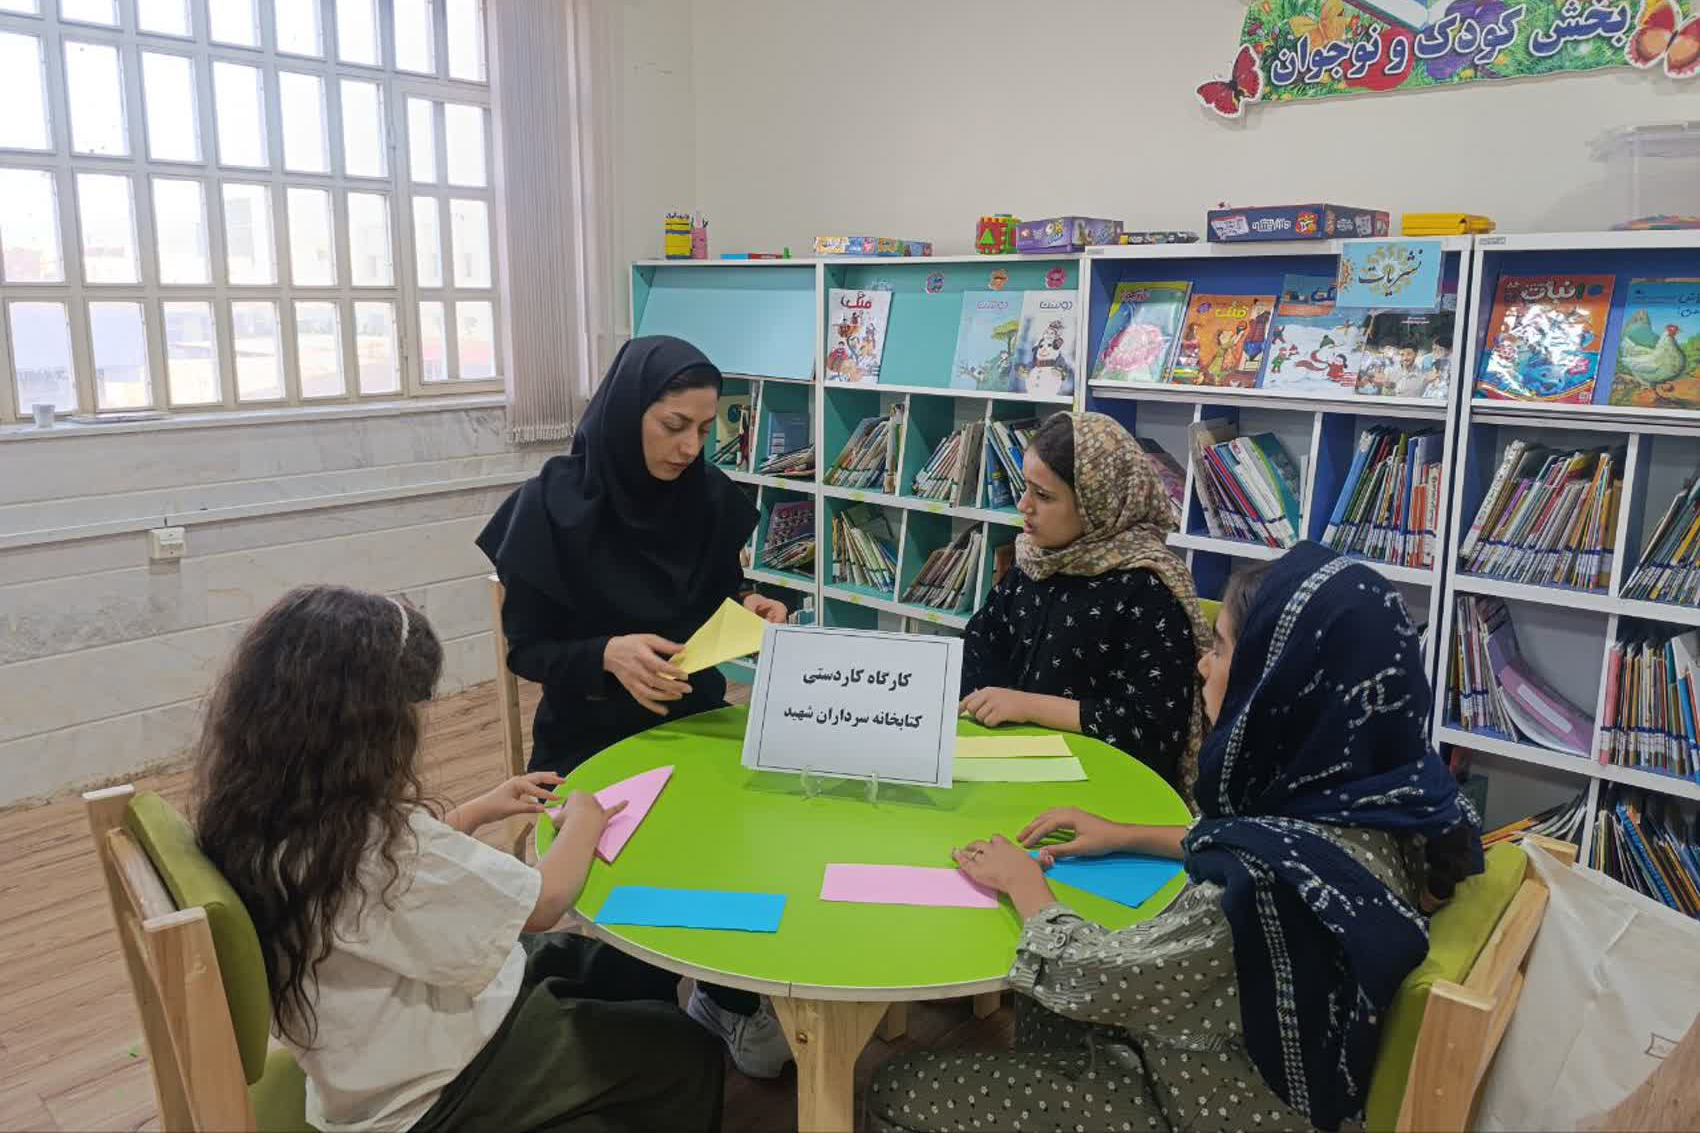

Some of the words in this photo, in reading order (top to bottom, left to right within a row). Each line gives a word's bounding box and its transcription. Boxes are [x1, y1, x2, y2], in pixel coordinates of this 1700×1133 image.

[1413, 4, 1525, 64] کودک
[1529, 0, 1631, 57] بخش
[1270, 22, 1382, 86] نوجوان
[1384, 35, 1407, 74] و
[1358, 248, 1424, 297] نشریات
[803, 668, 865, 687] کاردستی
[867, 671, 912, 691] کارگاه
[784, 704, 814, 721] شهید
[816, 707, 869, 727] سرداران
[872, 711, 923, 730] کتابخانه
